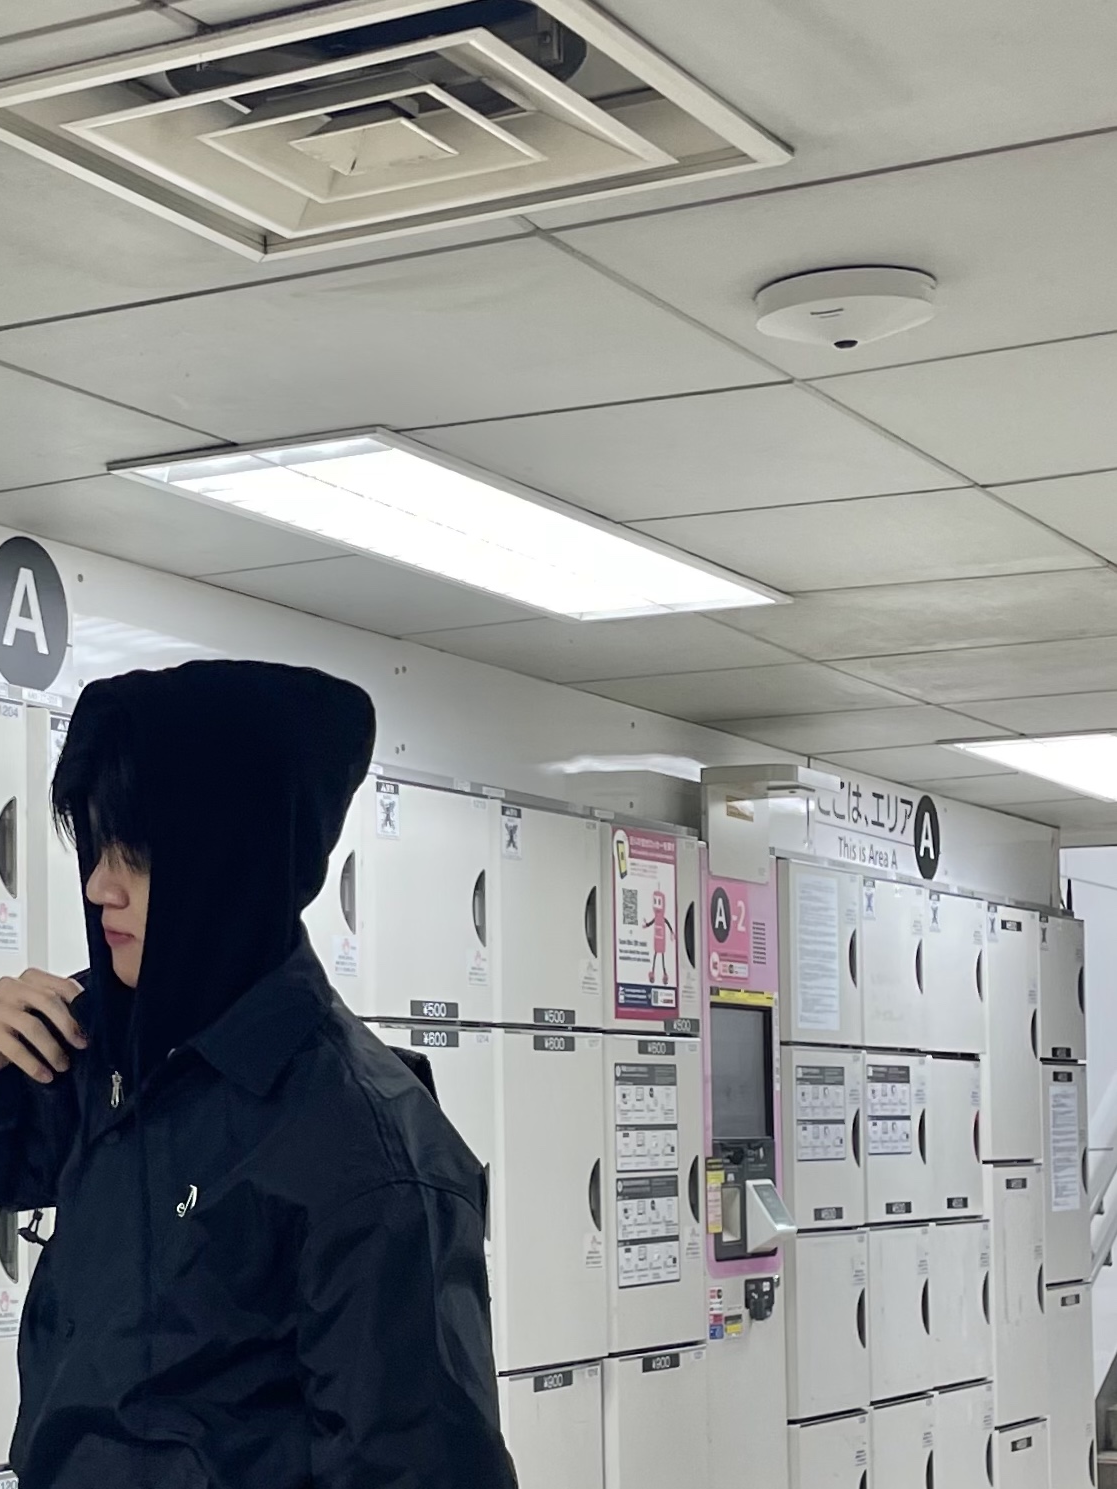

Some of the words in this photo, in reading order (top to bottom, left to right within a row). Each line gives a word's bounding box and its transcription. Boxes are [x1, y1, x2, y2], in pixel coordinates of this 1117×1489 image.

[2, 567, 49, 655] A
[838, 836, 856, 861] This
[859, 839, 866, 862] is
[868, 844, 889, 868] Area
[891, 849, 898, 870] A
[919, 811, 935, 860] A
